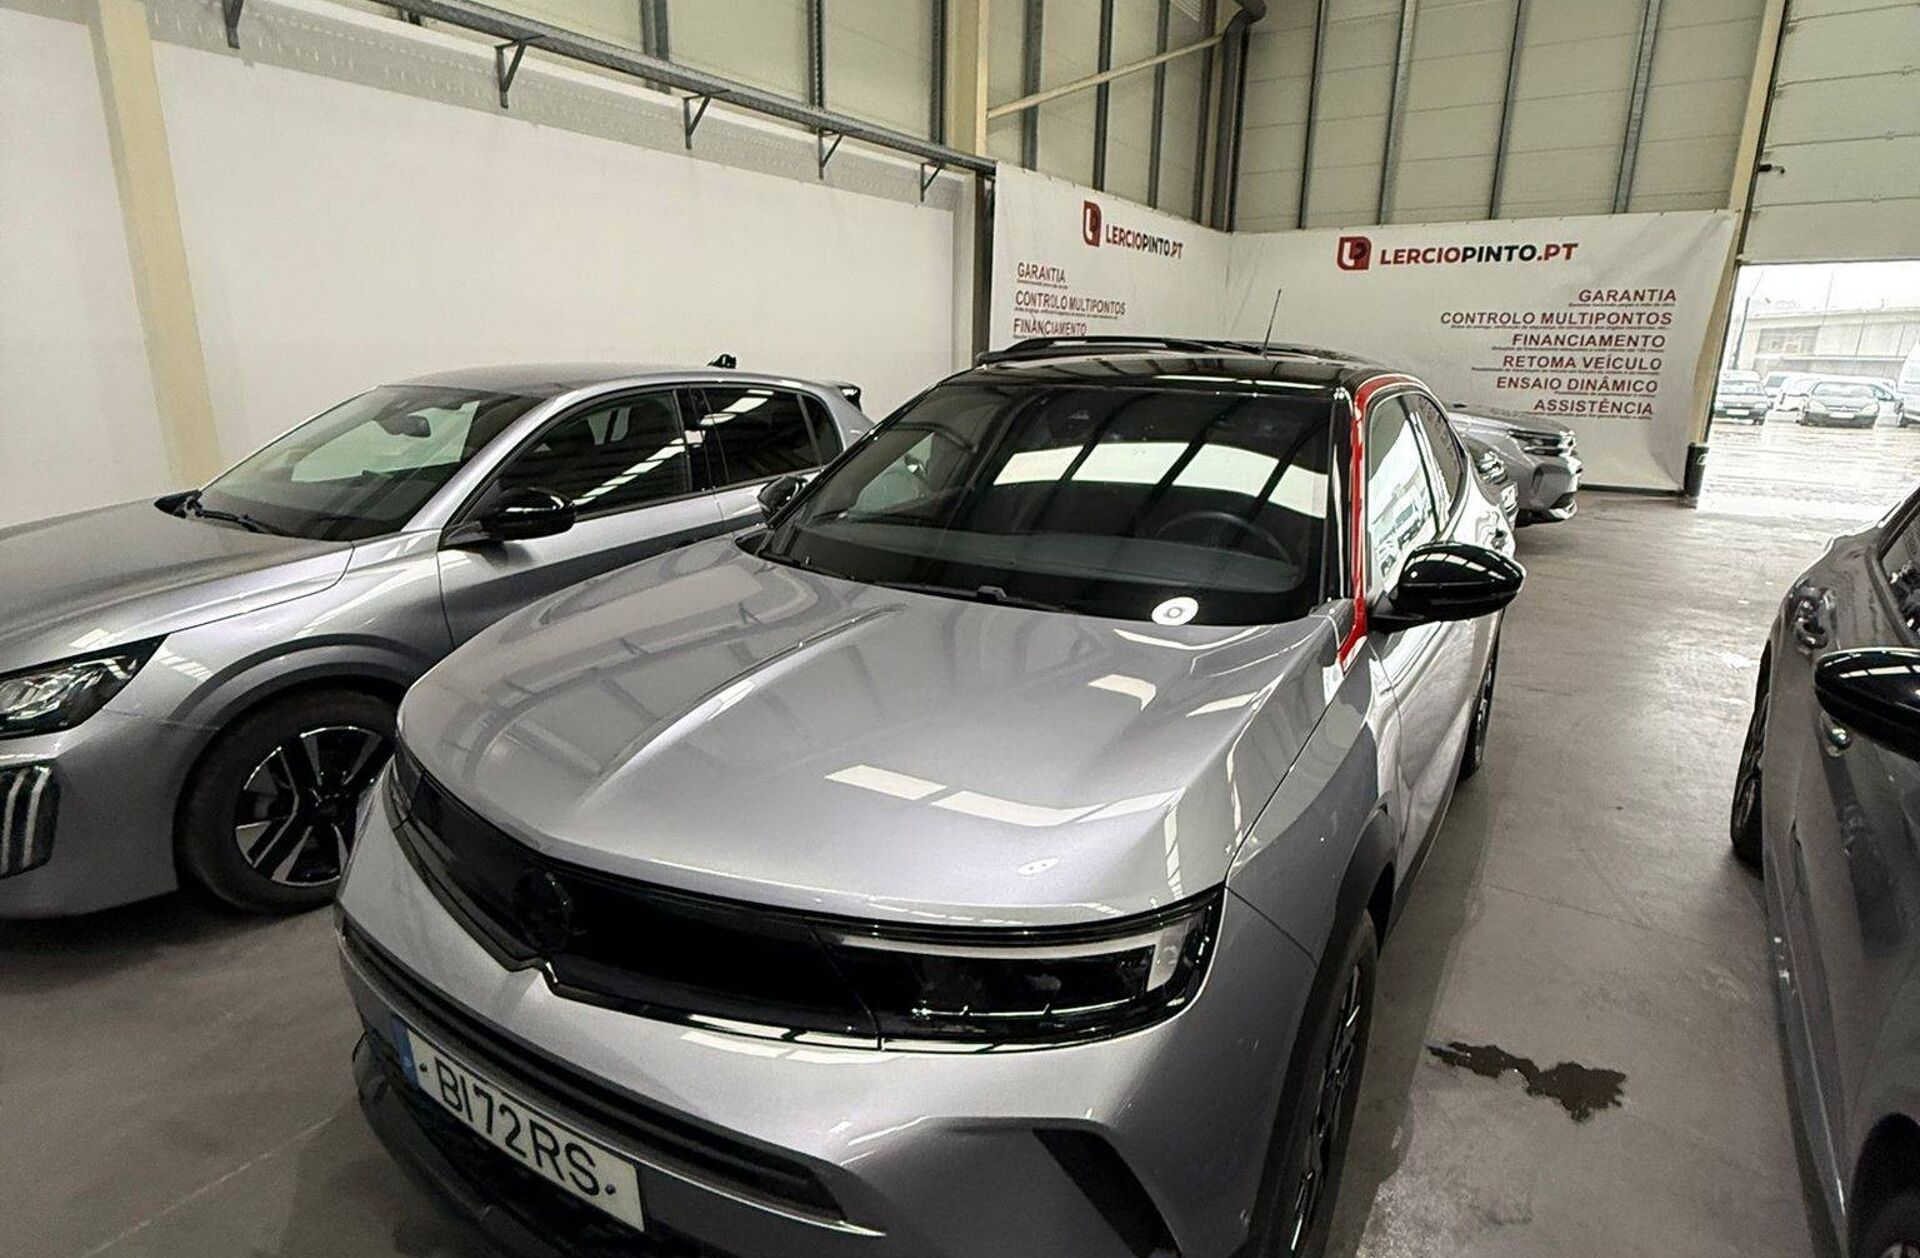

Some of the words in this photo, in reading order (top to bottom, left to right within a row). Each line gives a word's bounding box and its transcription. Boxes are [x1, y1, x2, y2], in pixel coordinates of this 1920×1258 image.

[1106, 224, 1183, 259] LERCIOPINTO.PT
[1380, 243, 1579, 265] LERCIOPINTO.PT
[1017, 262, 1066, 283] GARANTIA
[1015, 290, 1067, 310] CONTROLO
[1069, 296, 1126, 315] MULTIPONTOS
[1578, 289, 1677, 302] GARANTIA
[1440, 312, 1535, 325] CONTROLO
[1540, 312, 1673, 325] MULTIPONTOS
[1013, 318, 1087, 337] FINANCIAMENTO
[1512, 333, 1666, 348] FINANCIAMENTO
[1503, 355, 1576, 369] RETOMA
[1582, 354, 1662, 371] VEÍCULO
[1496, 376, 1562, 390] ENSAIO
[1567, 376, 1658, 393] DINÂMICO
[1534, 398, 1654, 415] ASSISTÊNCIA
